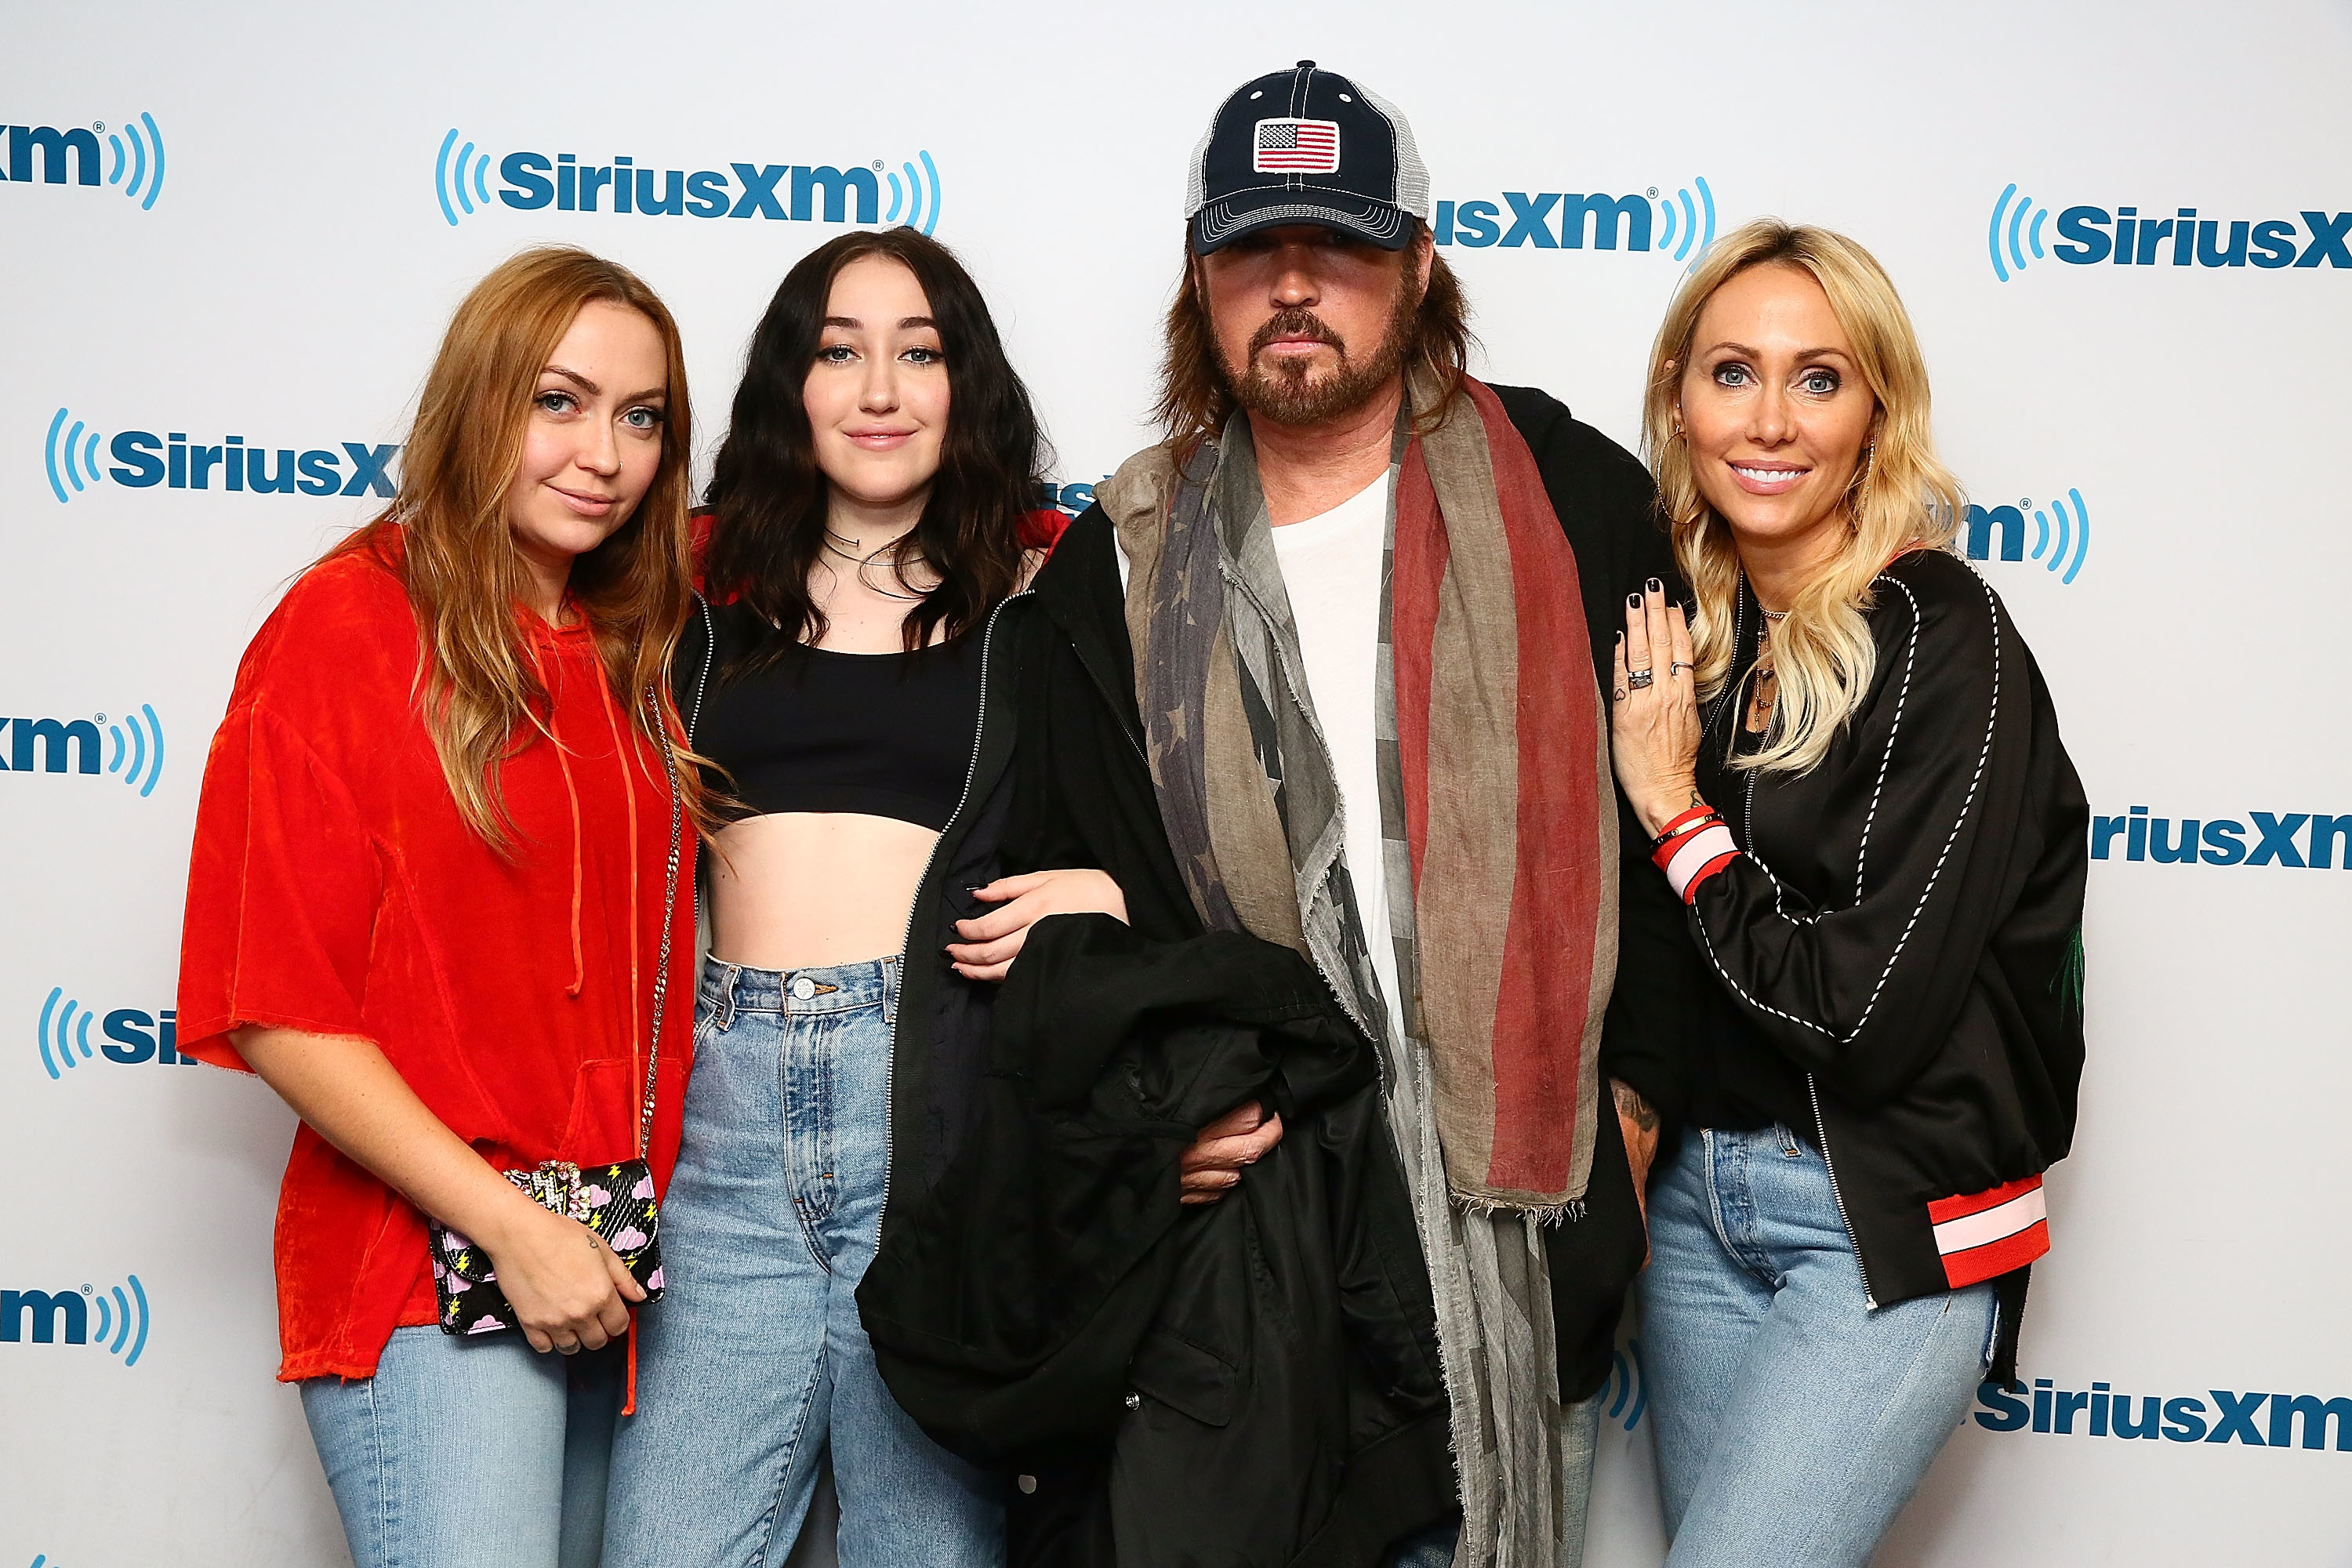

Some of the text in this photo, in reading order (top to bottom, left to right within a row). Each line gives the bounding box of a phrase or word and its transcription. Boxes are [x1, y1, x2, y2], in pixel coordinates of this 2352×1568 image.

[0, 124, 101, 186] m
[0, 717, 101, 775] m
[100, 1008, 198, 1065] Si
